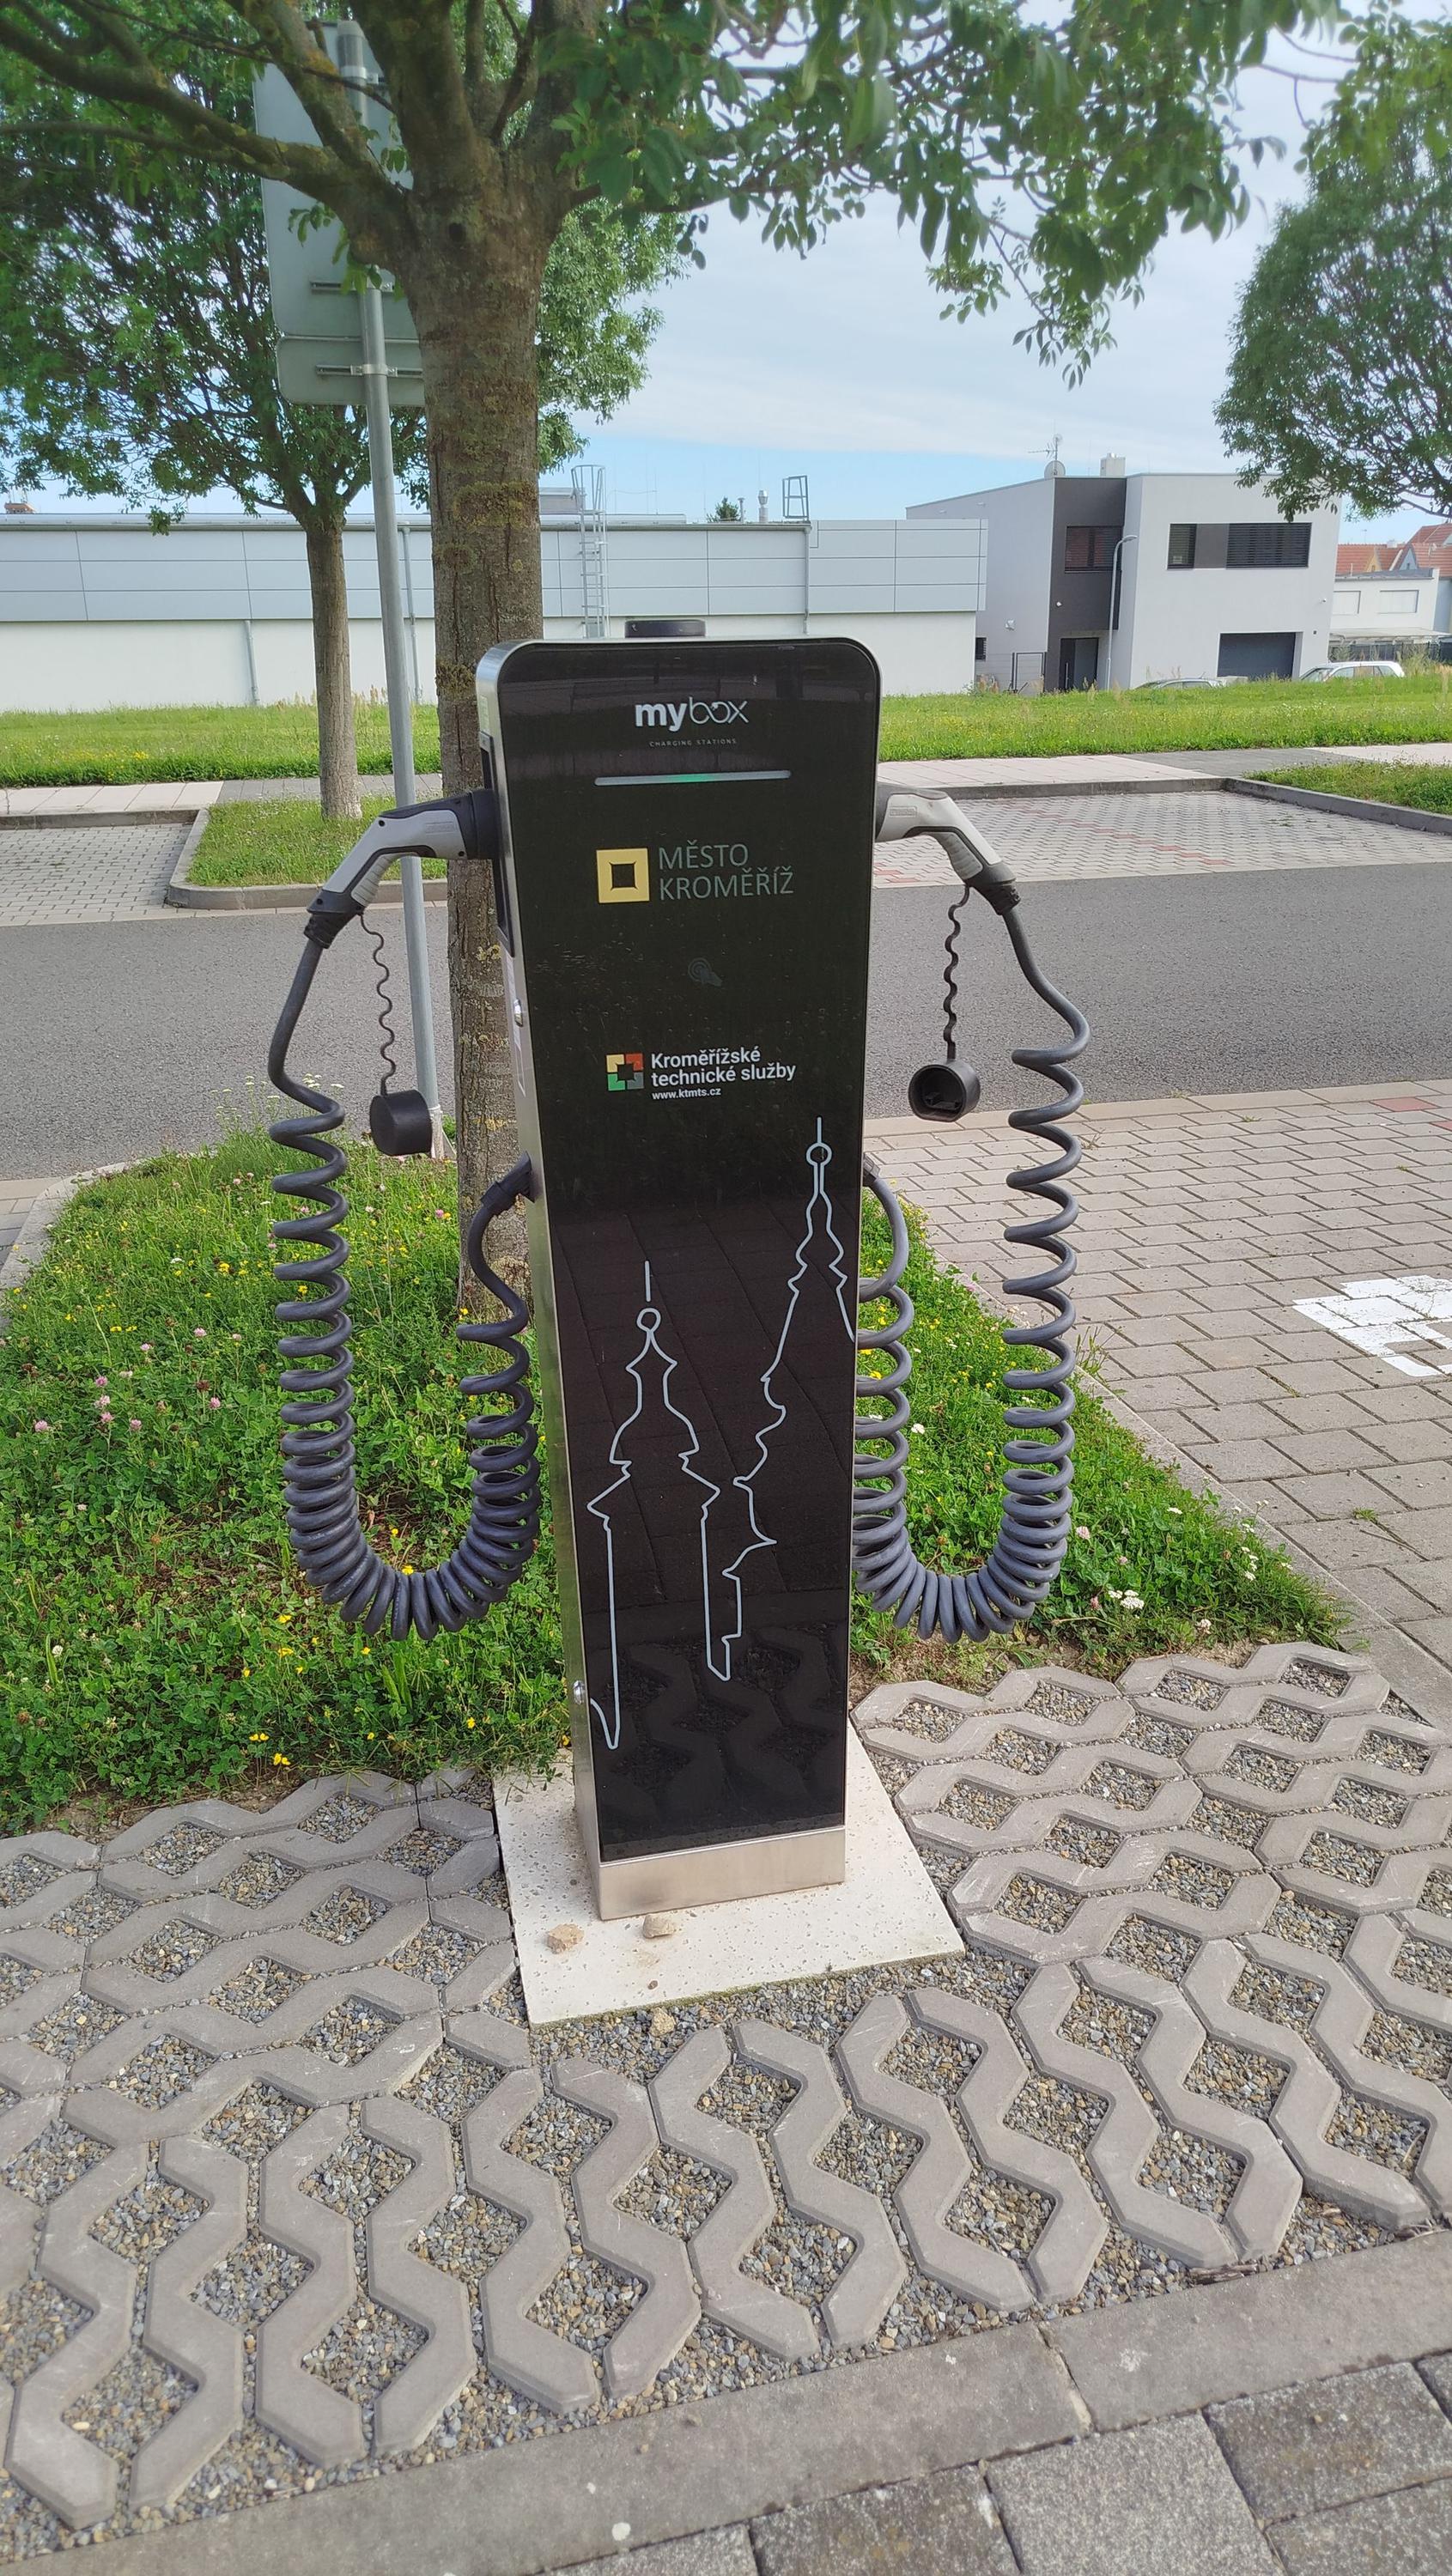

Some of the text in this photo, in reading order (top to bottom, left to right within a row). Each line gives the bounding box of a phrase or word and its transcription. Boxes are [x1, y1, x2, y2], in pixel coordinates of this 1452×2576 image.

[634, 696, 750, 732] mybox
[659, 839, 749, 870] MĚSTO
[659, 866, 794, 901] KROMĚŘÍŽ
[651, 1046, 761, 1069] Kroměřížské
[651, 1061, 796, 1087] technické služby
[652, 1087, 721, 1100] www.ktmts.cz
